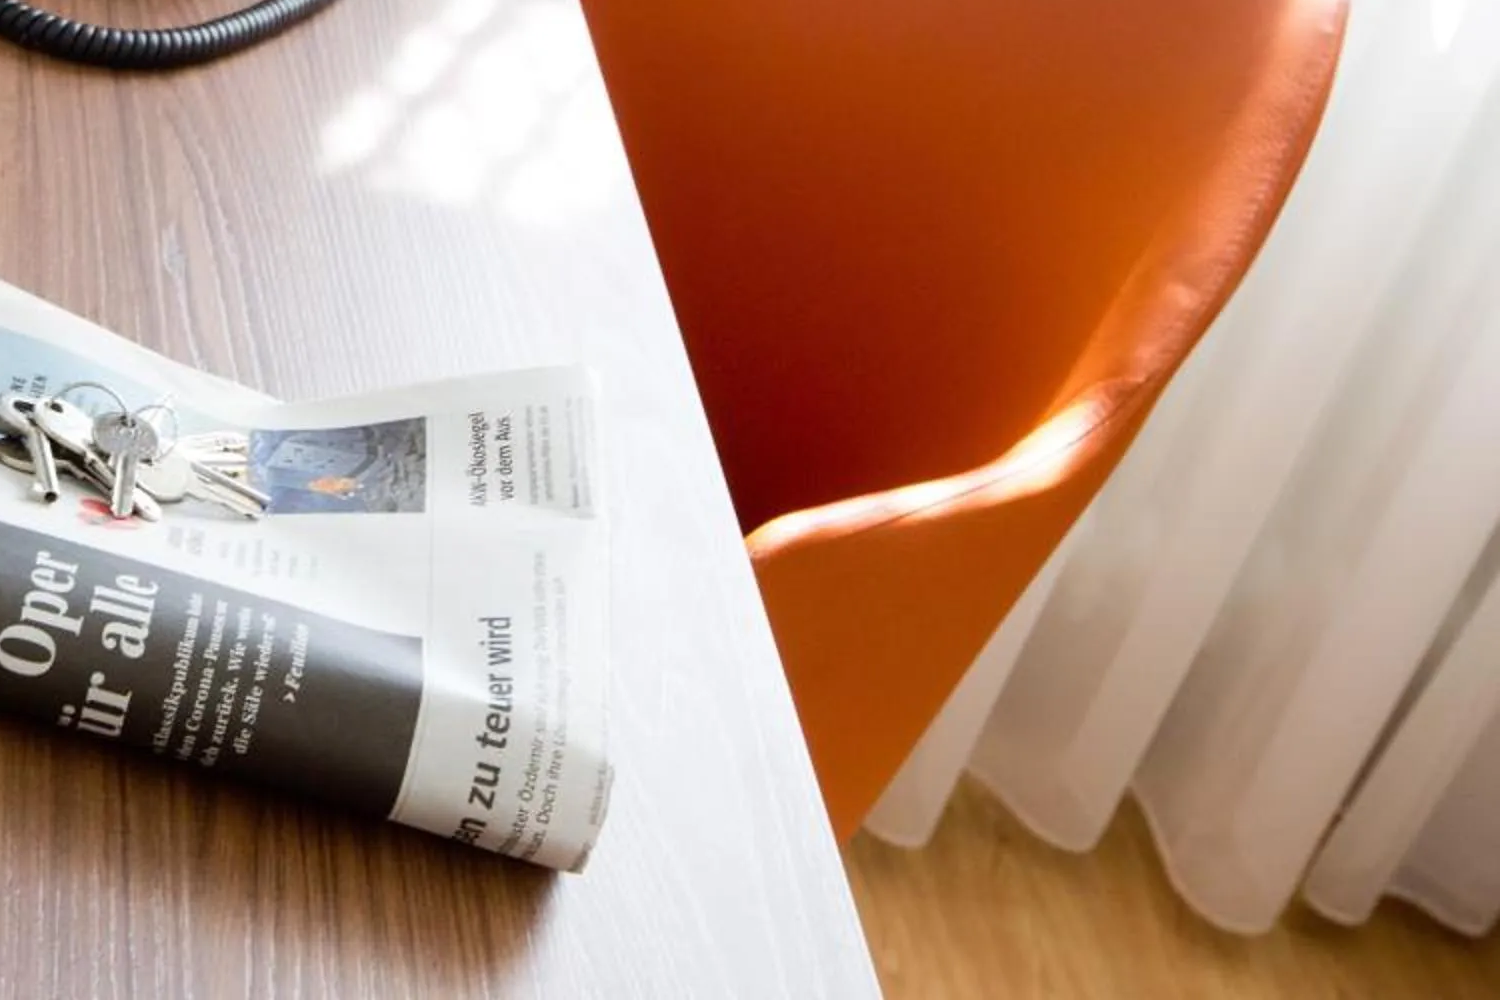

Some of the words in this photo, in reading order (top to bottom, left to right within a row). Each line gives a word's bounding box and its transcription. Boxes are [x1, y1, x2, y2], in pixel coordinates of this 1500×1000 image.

[493, 416, 512, 442] Aus
[493, 445, 513, 476] dem
[498, 479, 515, 500] vor
[89, 573, 159, 660] alle
[477, 616, 512, 666] wird
[211, 677, 241, 745] zurück.
[227, 642, 248, 672] Wie
[240, 685, 264, 725] Säle
[475, 672, 514, 750] teuer
[232, 728, 253, 755] die
[466, 761, 501, 810] zu
[534, 783, 558, 825] Doch
